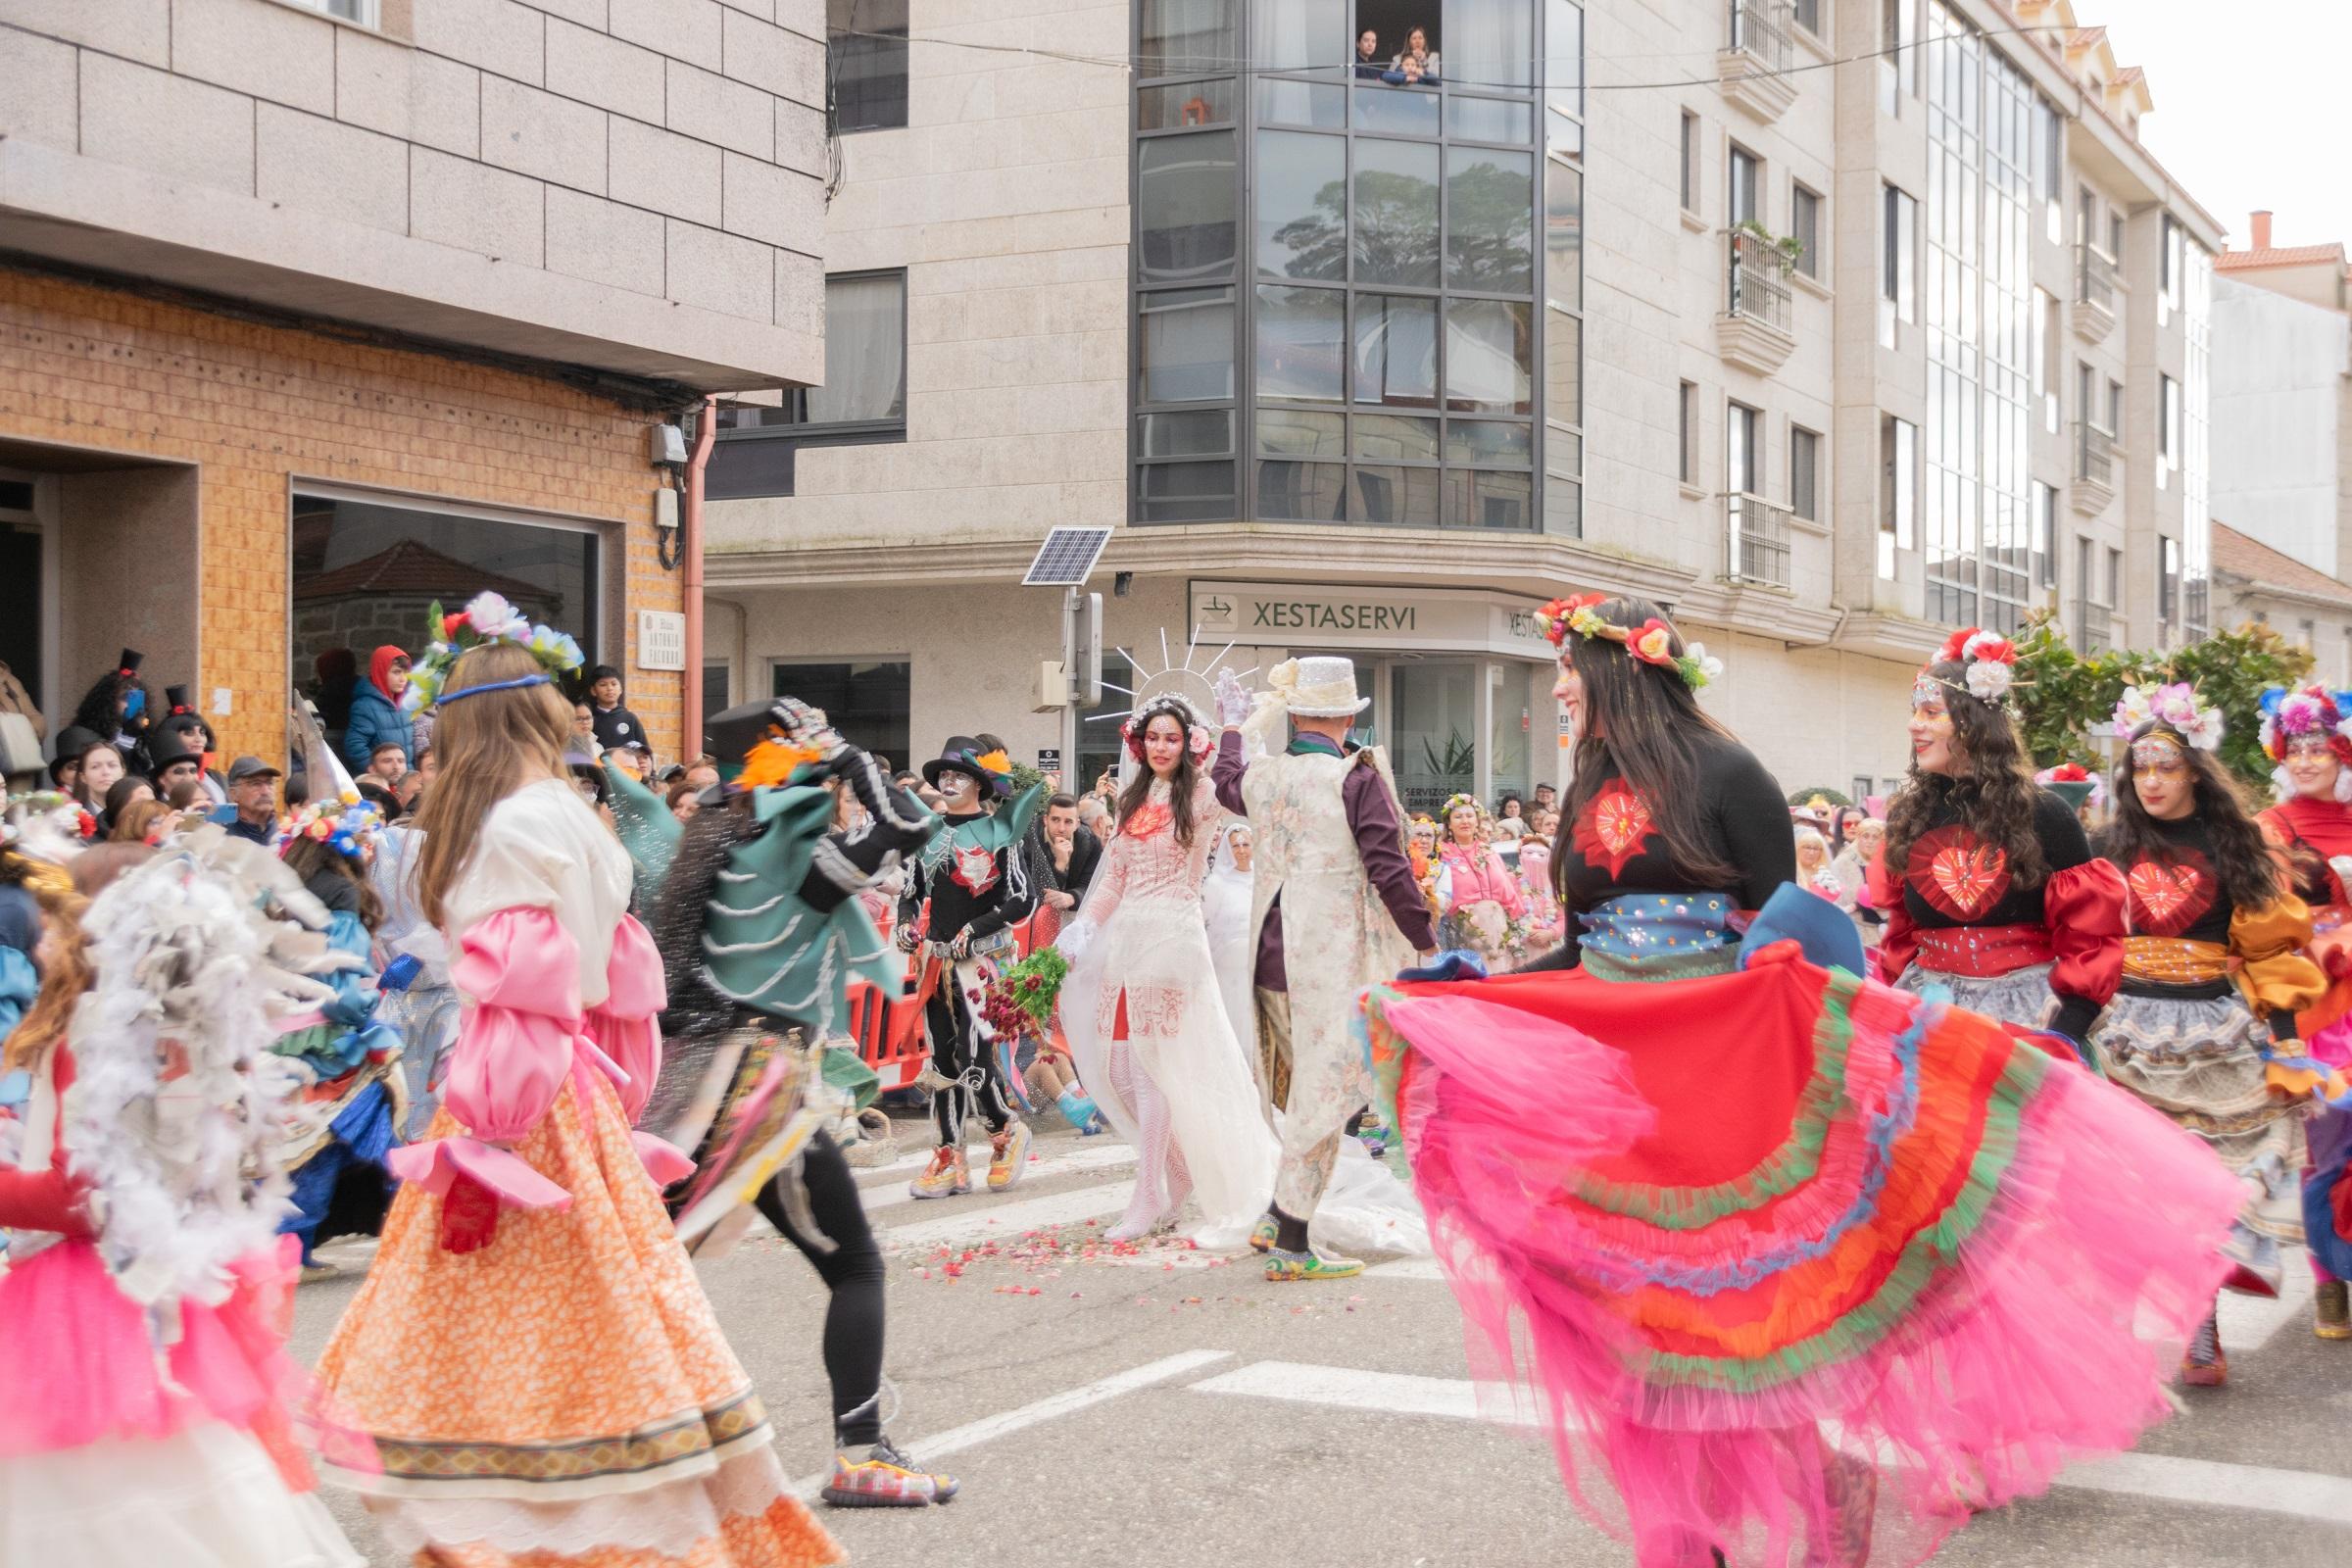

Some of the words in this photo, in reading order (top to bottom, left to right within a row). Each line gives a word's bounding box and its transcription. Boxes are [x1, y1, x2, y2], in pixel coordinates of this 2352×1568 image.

[1253, 602, 1416, 630] XESTASERVI
[650, 632, 679, 648] ANTONIO
[1405, 787, 1452, 797] SERVIZOS
[1408, 798, 1446, 808] EMPRES
